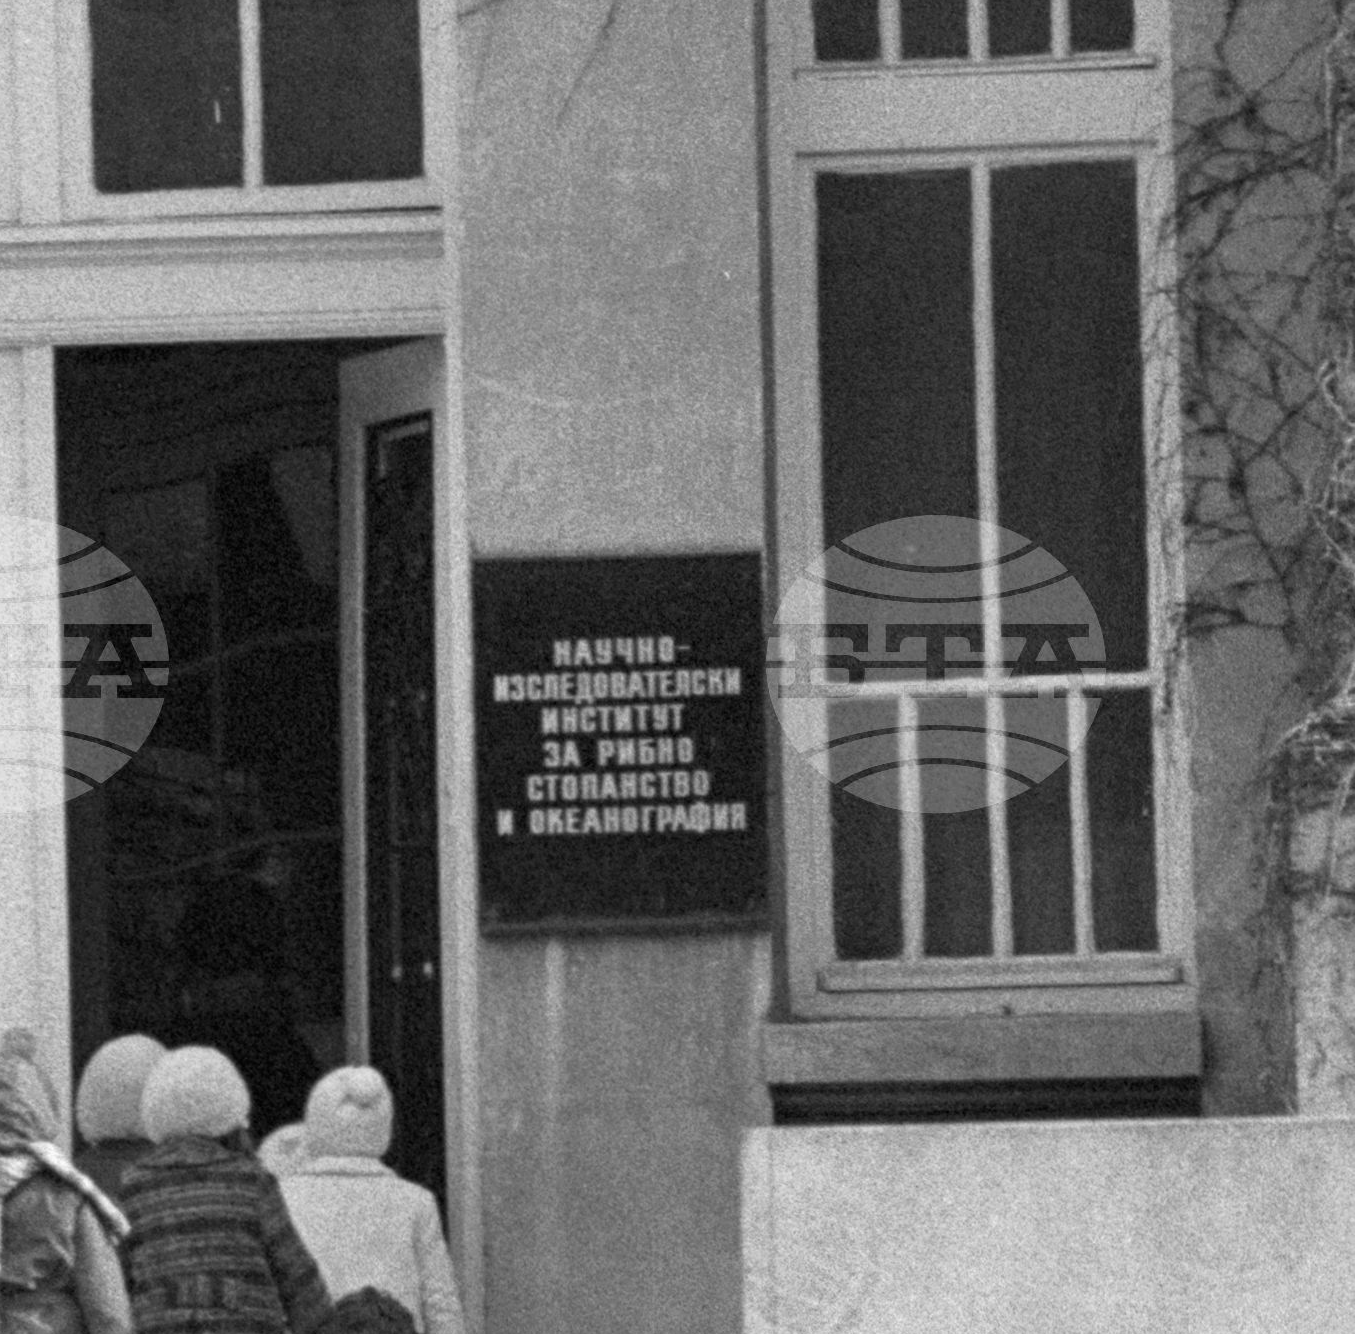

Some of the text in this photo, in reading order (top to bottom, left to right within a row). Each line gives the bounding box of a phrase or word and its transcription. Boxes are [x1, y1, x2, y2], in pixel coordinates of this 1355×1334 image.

[553, 635, 691, 667] НАУЧНО-
[493, 667, 742, 704] ИЗСЛЕДОВАТЕЛСКИ
[541, 702, 685, 734] ИНСТИТУТ
[543, 737, 695, 768] ЗА РИБНО
[527, 769, 712, 802] СТОПАНСТВО
[497, 801, 747, 836] И ОКЕАНОГРАФИЯ
